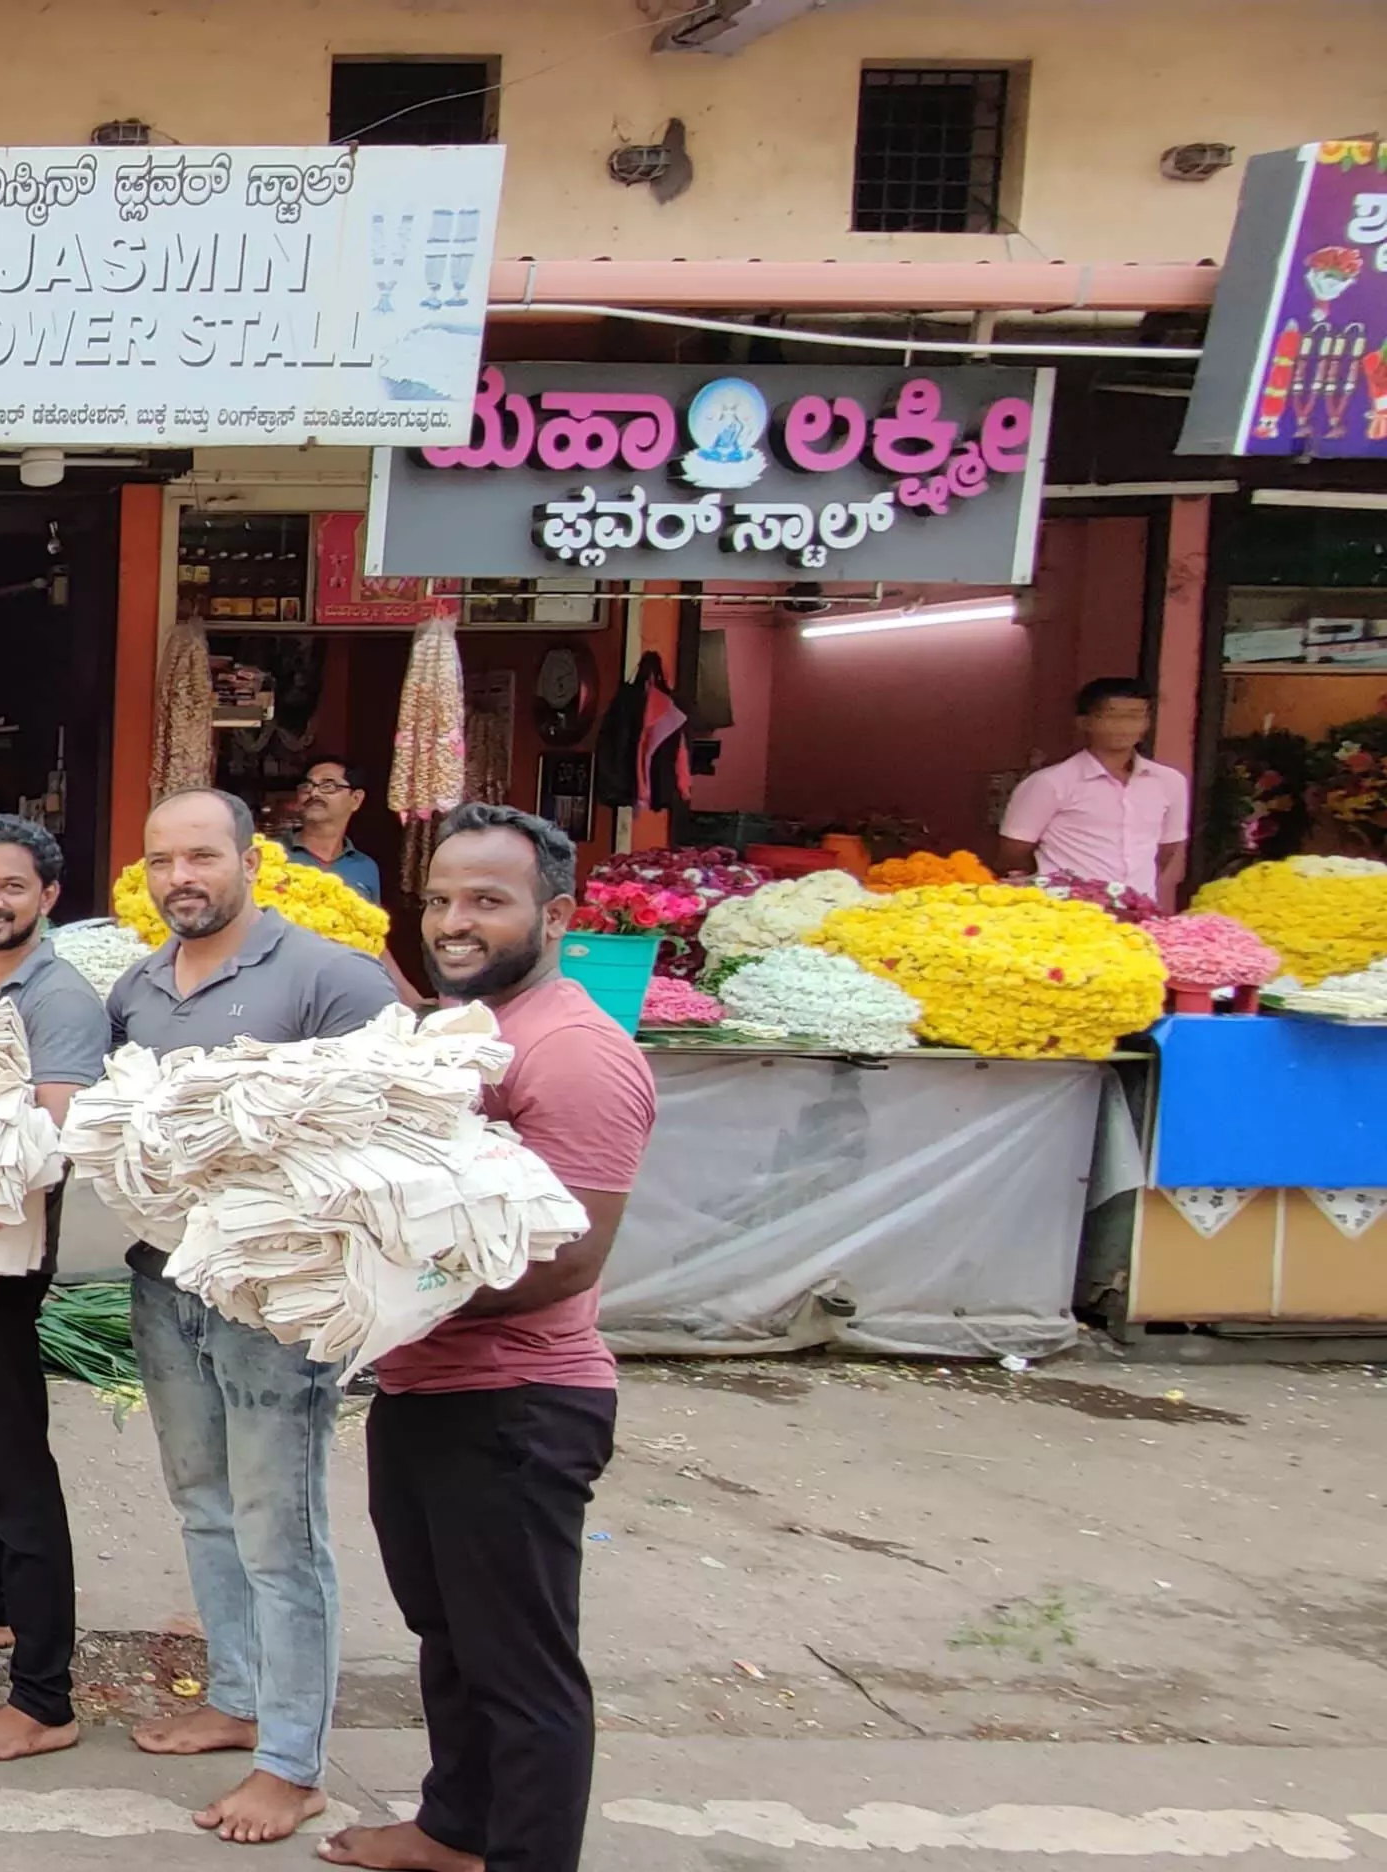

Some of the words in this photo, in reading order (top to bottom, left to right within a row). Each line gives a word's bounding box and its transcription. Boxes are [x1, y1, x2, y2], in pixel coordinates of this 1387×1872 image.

[245, 151, 356, 224] ಸ್ಟಾಲ್
[173, 309, 376, 369] STALL
[174, 406, 210, 432] ಮತ್ತು
[541, 485, 723, 567] ಫ್ಲವರ್
[732, 491, 895, 568] ಸ್ಟಾಲ್
